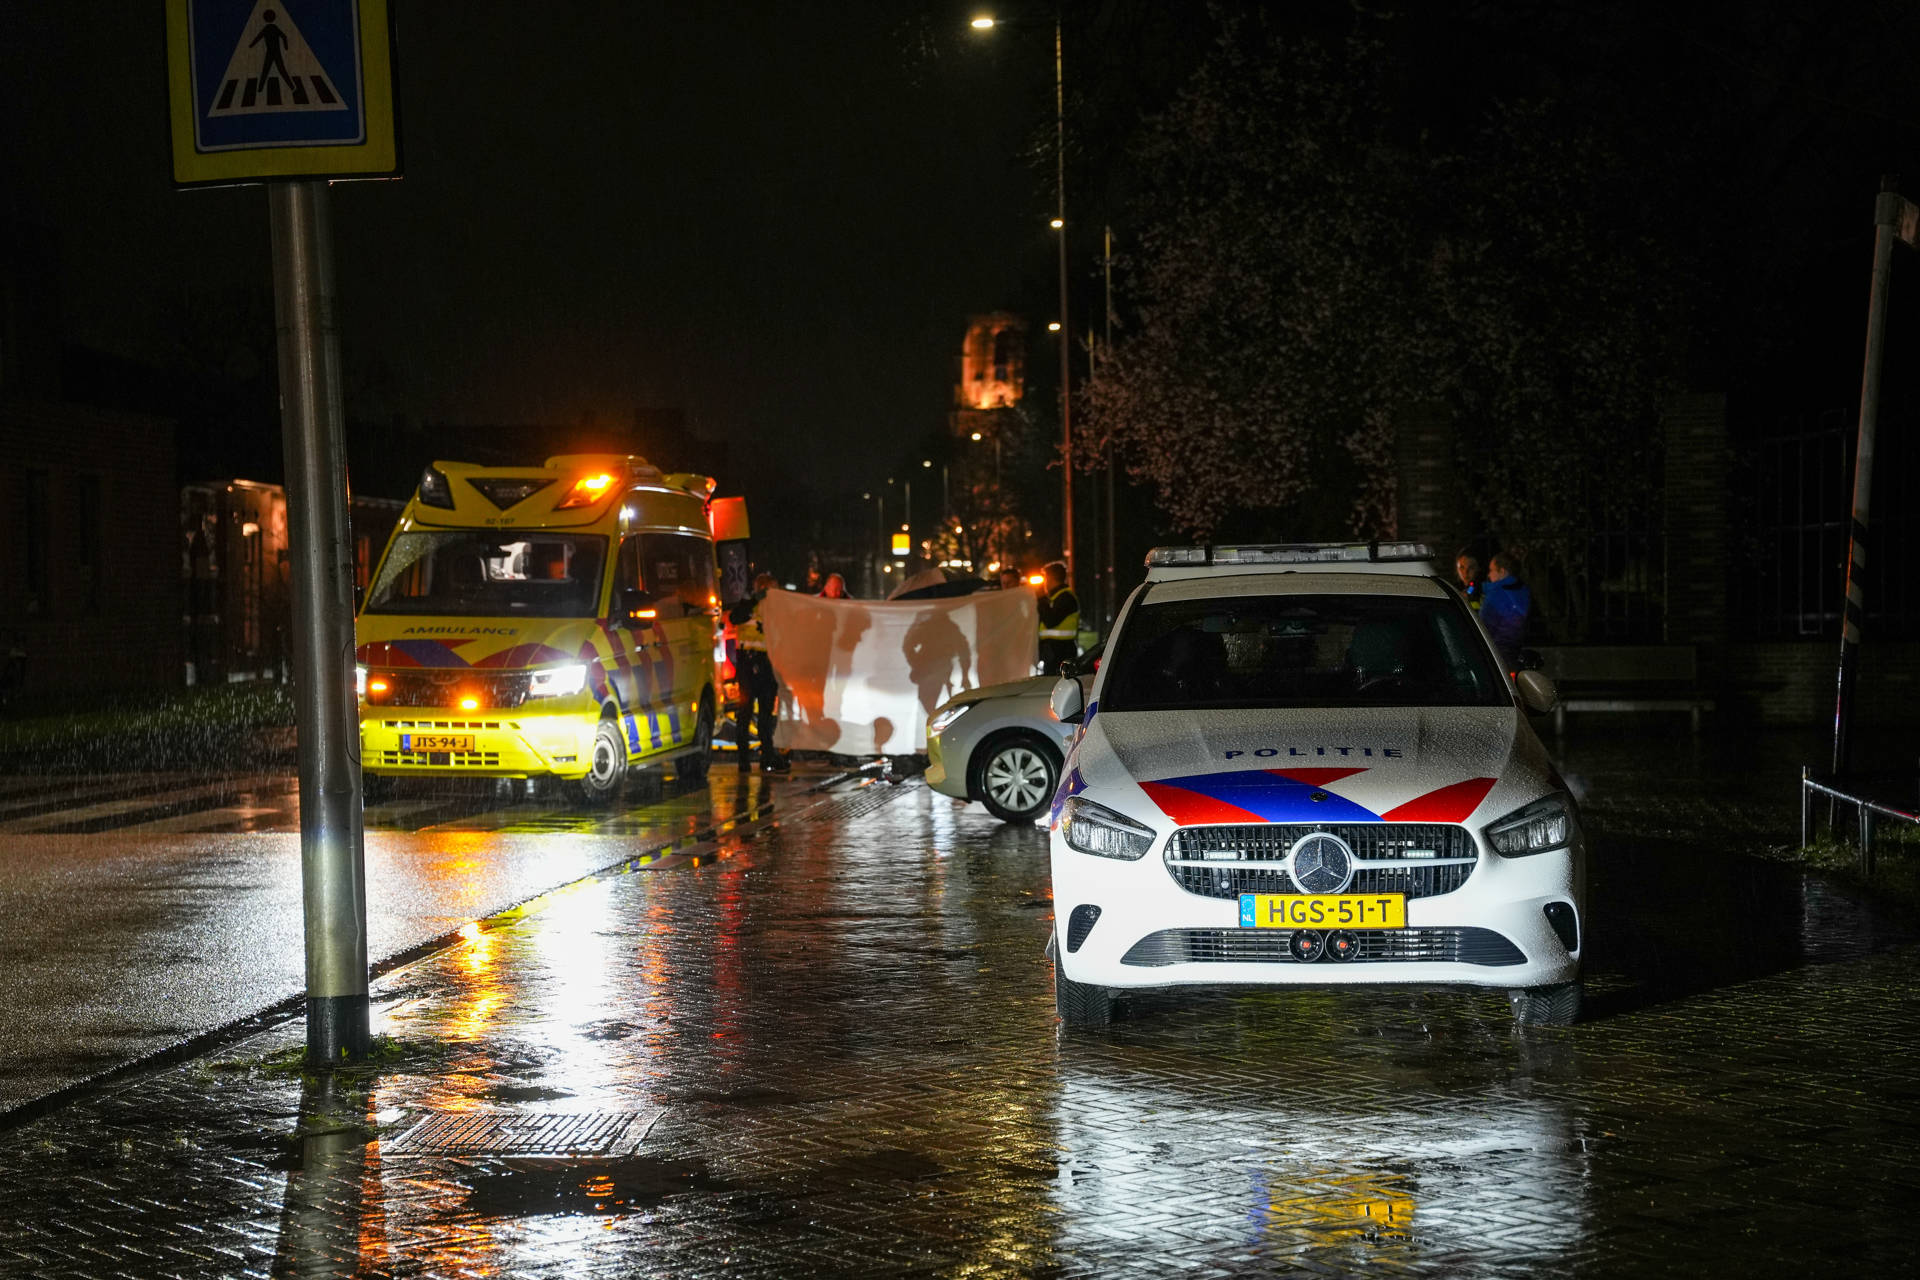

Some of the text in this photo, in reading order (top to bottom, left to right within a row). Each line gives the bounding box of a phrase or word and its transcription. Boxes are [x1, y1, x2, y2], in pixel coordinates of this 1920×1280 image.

[402, 625, 519, 637] AMBULANCE
[414, 737, 467, 748] JTS-94-J
[1224, 747, 1403, 759] POLITIE
[1242, 899, 1392, 923] NL HGS-51-T
